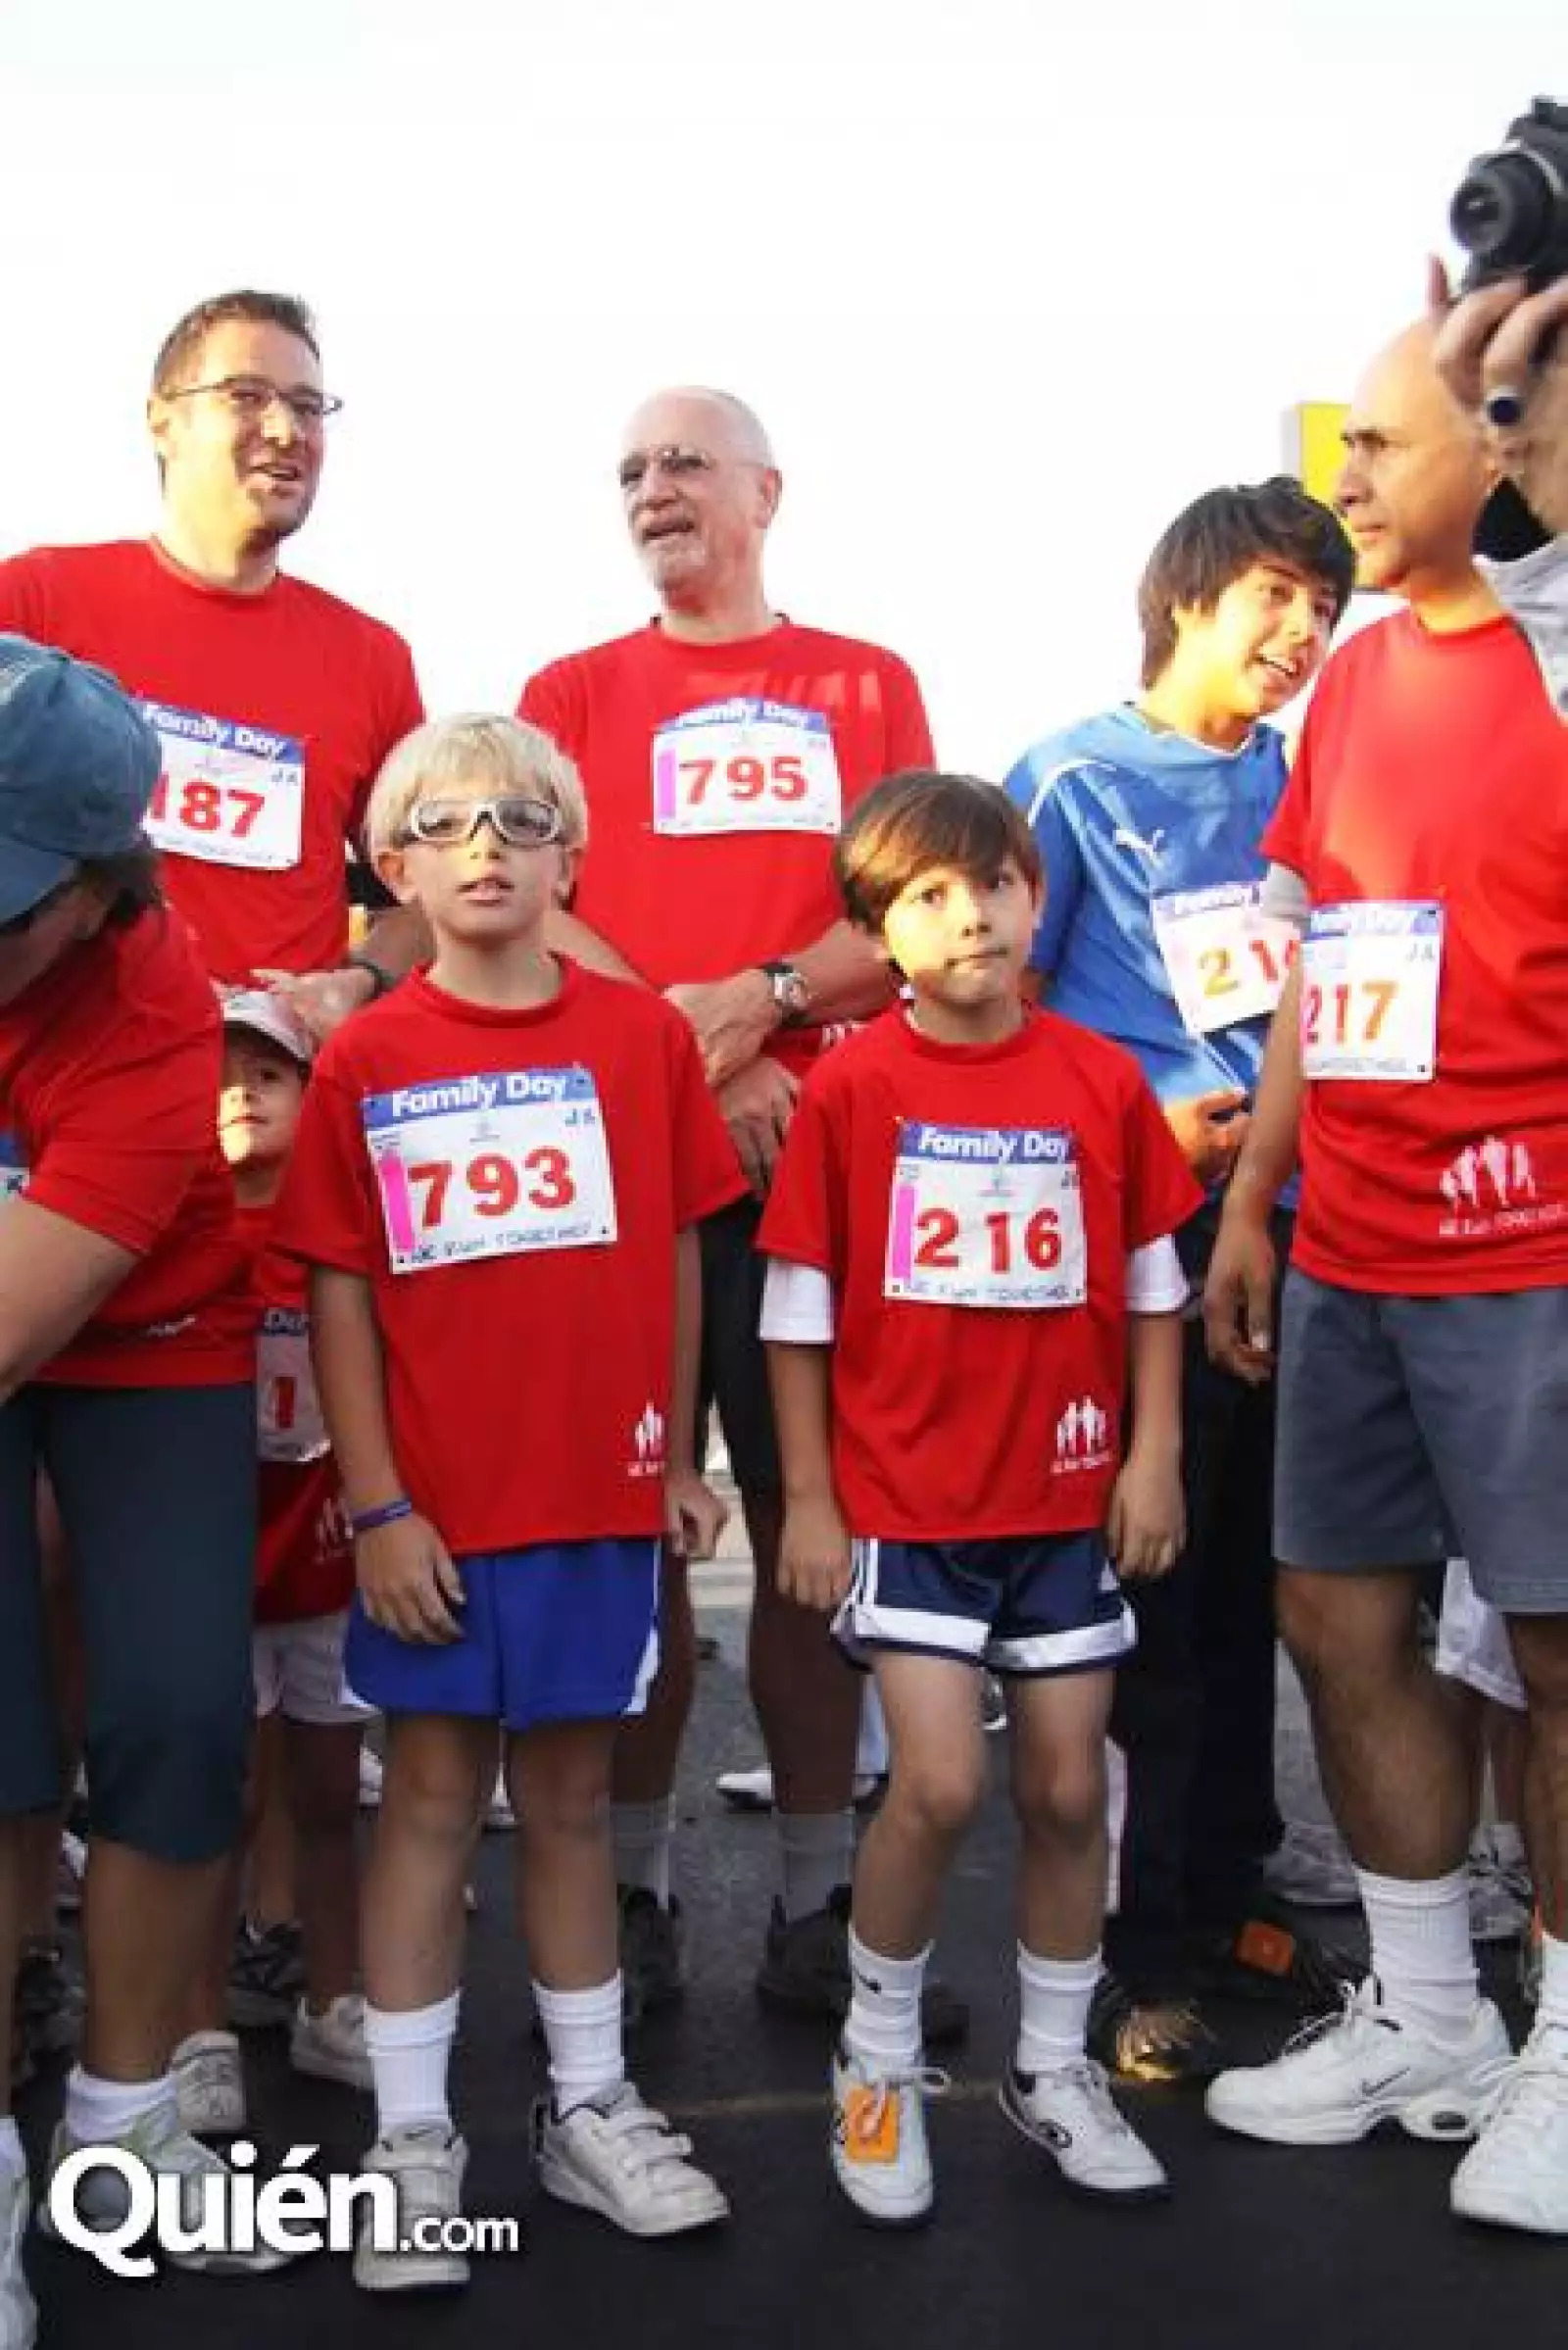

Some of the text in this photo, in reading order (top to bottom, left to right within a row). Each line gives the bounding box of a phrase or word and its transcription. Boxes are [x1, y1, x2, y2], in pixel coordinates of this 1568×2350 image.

[233, 725, 285, 757] Day
[679, 756, 808, 805] 795
[392, 1074, 567, 1118] Family Day
[918, 1127, 1069, 1163] Family Day
[407, 1149, 578, 1228] 793
[913, 1207, 1061, 1275] 216
